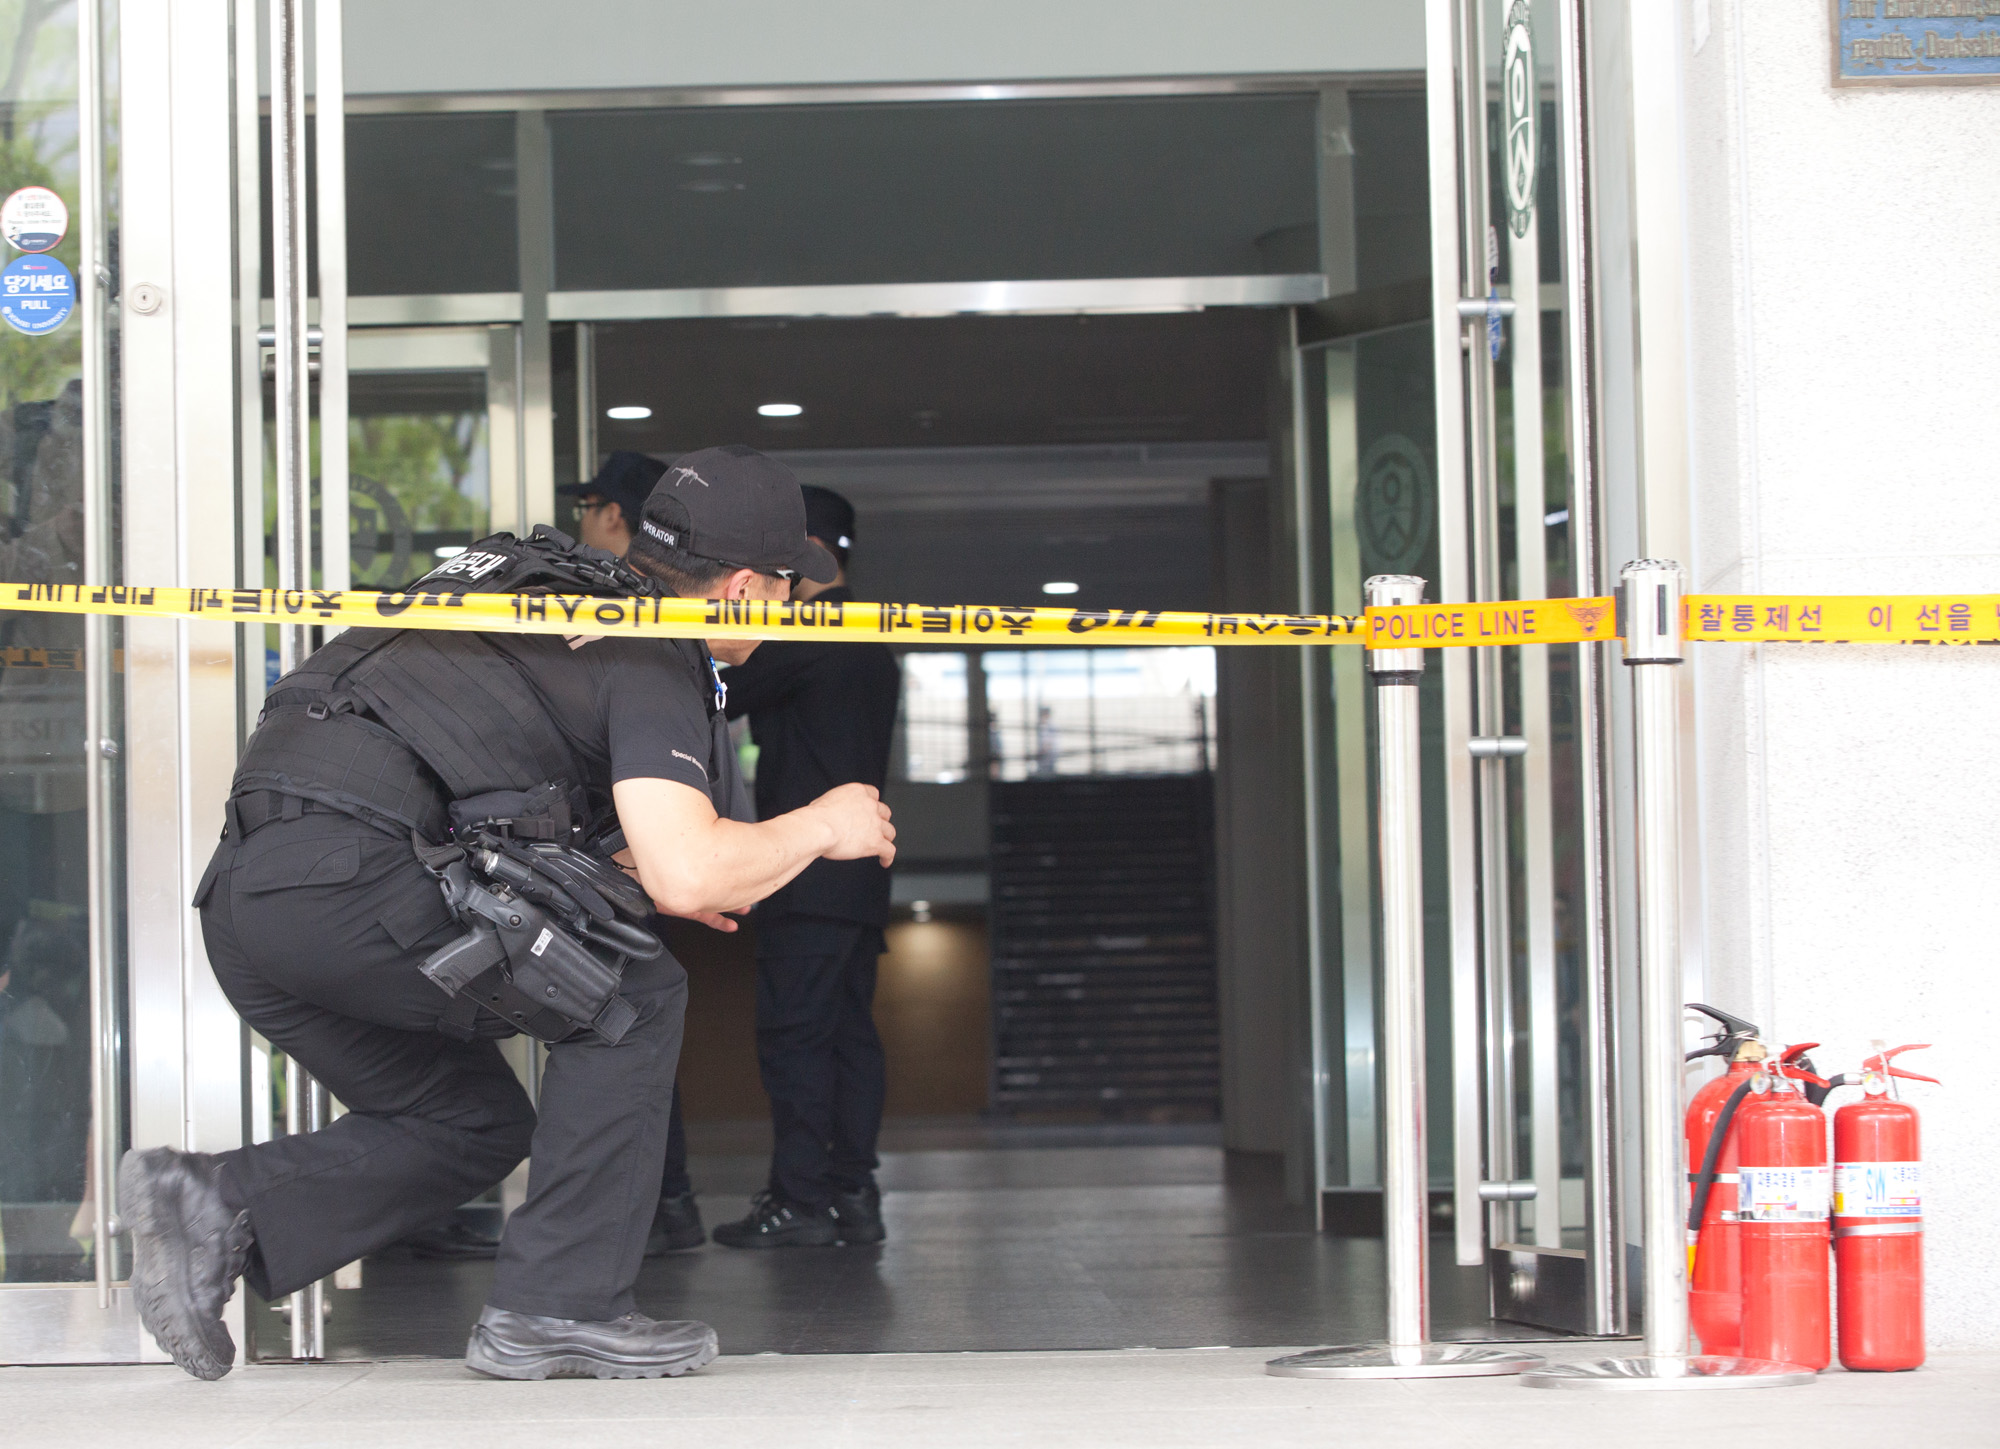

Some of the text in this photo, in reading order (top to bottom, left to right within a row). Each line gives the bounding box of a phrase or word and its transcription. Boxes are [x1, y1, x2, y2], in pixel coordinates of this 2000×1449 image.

[4, 275, 69, 293] 당기세요
[21, 300, 51, 310] PULL
[643, 520, 675, 546] OPERATOR
[1373, 608, 1536, 640] POLICE LINE
[1868, 604, 1892, 632] 이
[1916, 602, 1973, 633] 선을
